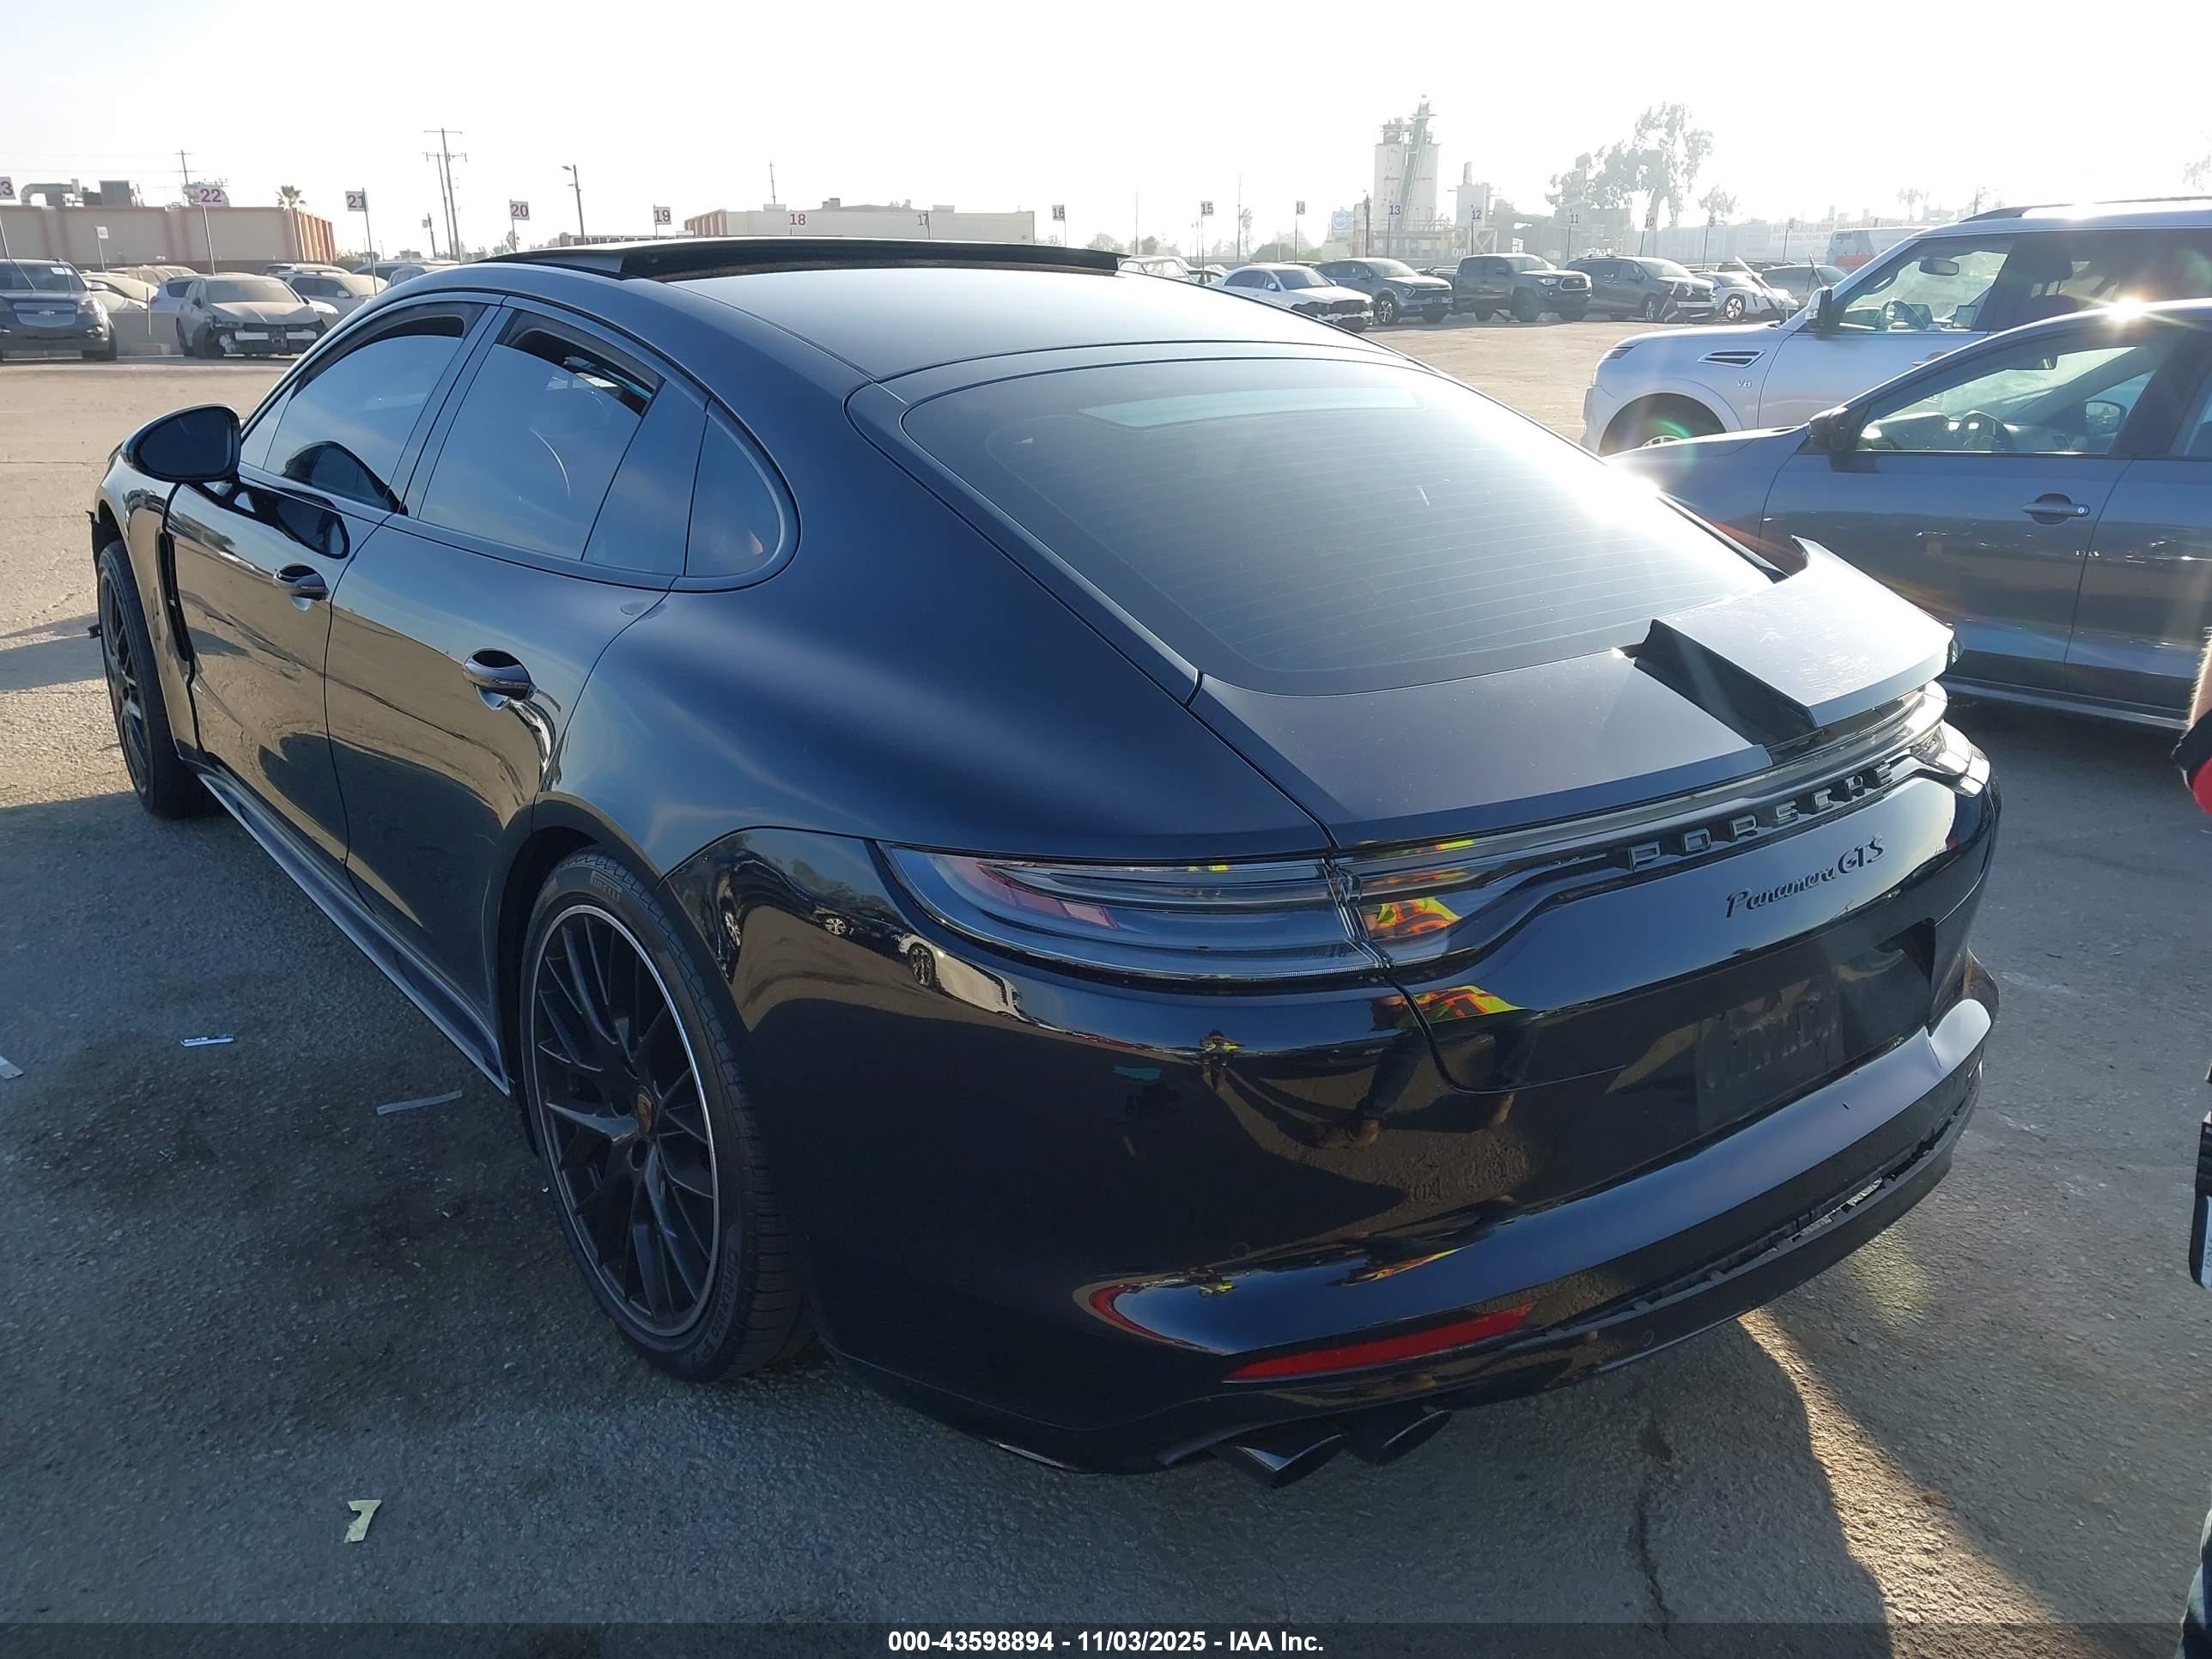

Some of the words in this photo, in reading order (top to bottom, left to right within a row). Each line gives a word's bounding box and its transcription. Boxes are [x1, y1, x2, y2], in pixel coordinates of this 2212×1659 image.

[199, 188, 222, 203] 22
[346, 194, 366, 209] 21
[510, 204, 529, 217] 20
[1201, 203, 1213, 215] 15
[1389, 204, 1401, 216] 13
[1471, 209, 1482, 220] 12
[653, 210, 671, 222] 19
[789, 213, 805, 226] 18
[1570, 214, 1579, 224] 11
[1644, 216, 1655, 228] 10
[1708, 216, 1716, 228] 9
[1628, 761, 1893, 872] PORSCHE
[1725, 866, 1837, 919] Panamera
[1838, 831, 1884, 874] GTS
